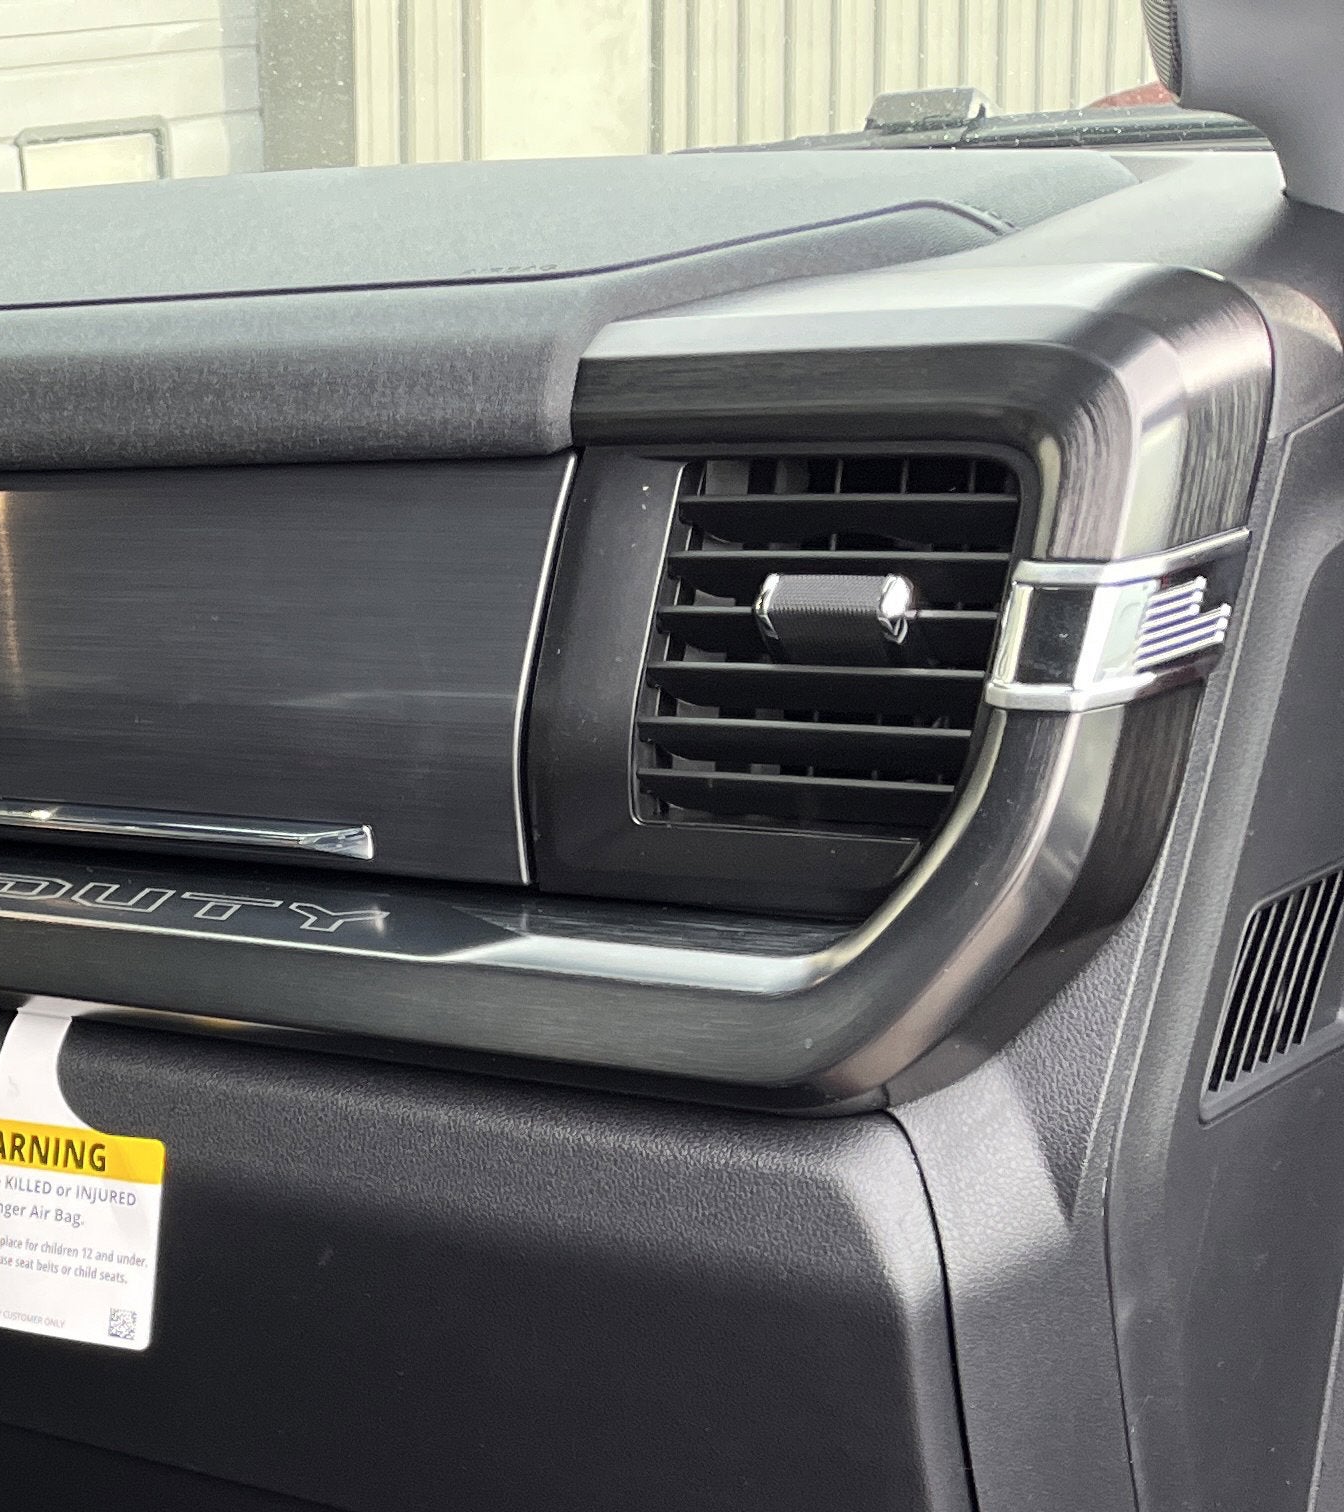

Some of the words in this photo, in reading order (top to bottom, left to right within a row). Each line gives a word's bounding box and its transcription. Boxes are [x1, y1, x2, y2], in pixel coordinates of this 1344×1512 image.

[5, 1176, 51, 1195] KILLED
[56, 1187, 71, 1197] or
[76, 1185, 136, 1206] INJURED
[30, 1205, 49, 1220] Air
[55, 1208, 84, 1227] Bag.
[0, 1236, 22, 1249] place
[25, 1239, 38, 1251] for
[41, 1241, 78, 1258] children
[82, 1247, 93, 1259] 12
[95, 1250, 113, 1262] and
[117, 1253, 148, 1268] under.
[16, 1258, 34, 1270] seat
[36, 1260, 58, 1273] belts
[61, 1265, 72, 1275] or
[74, 1265, 97, 1279] child
[100, 1270, 128, 1284] seats.
